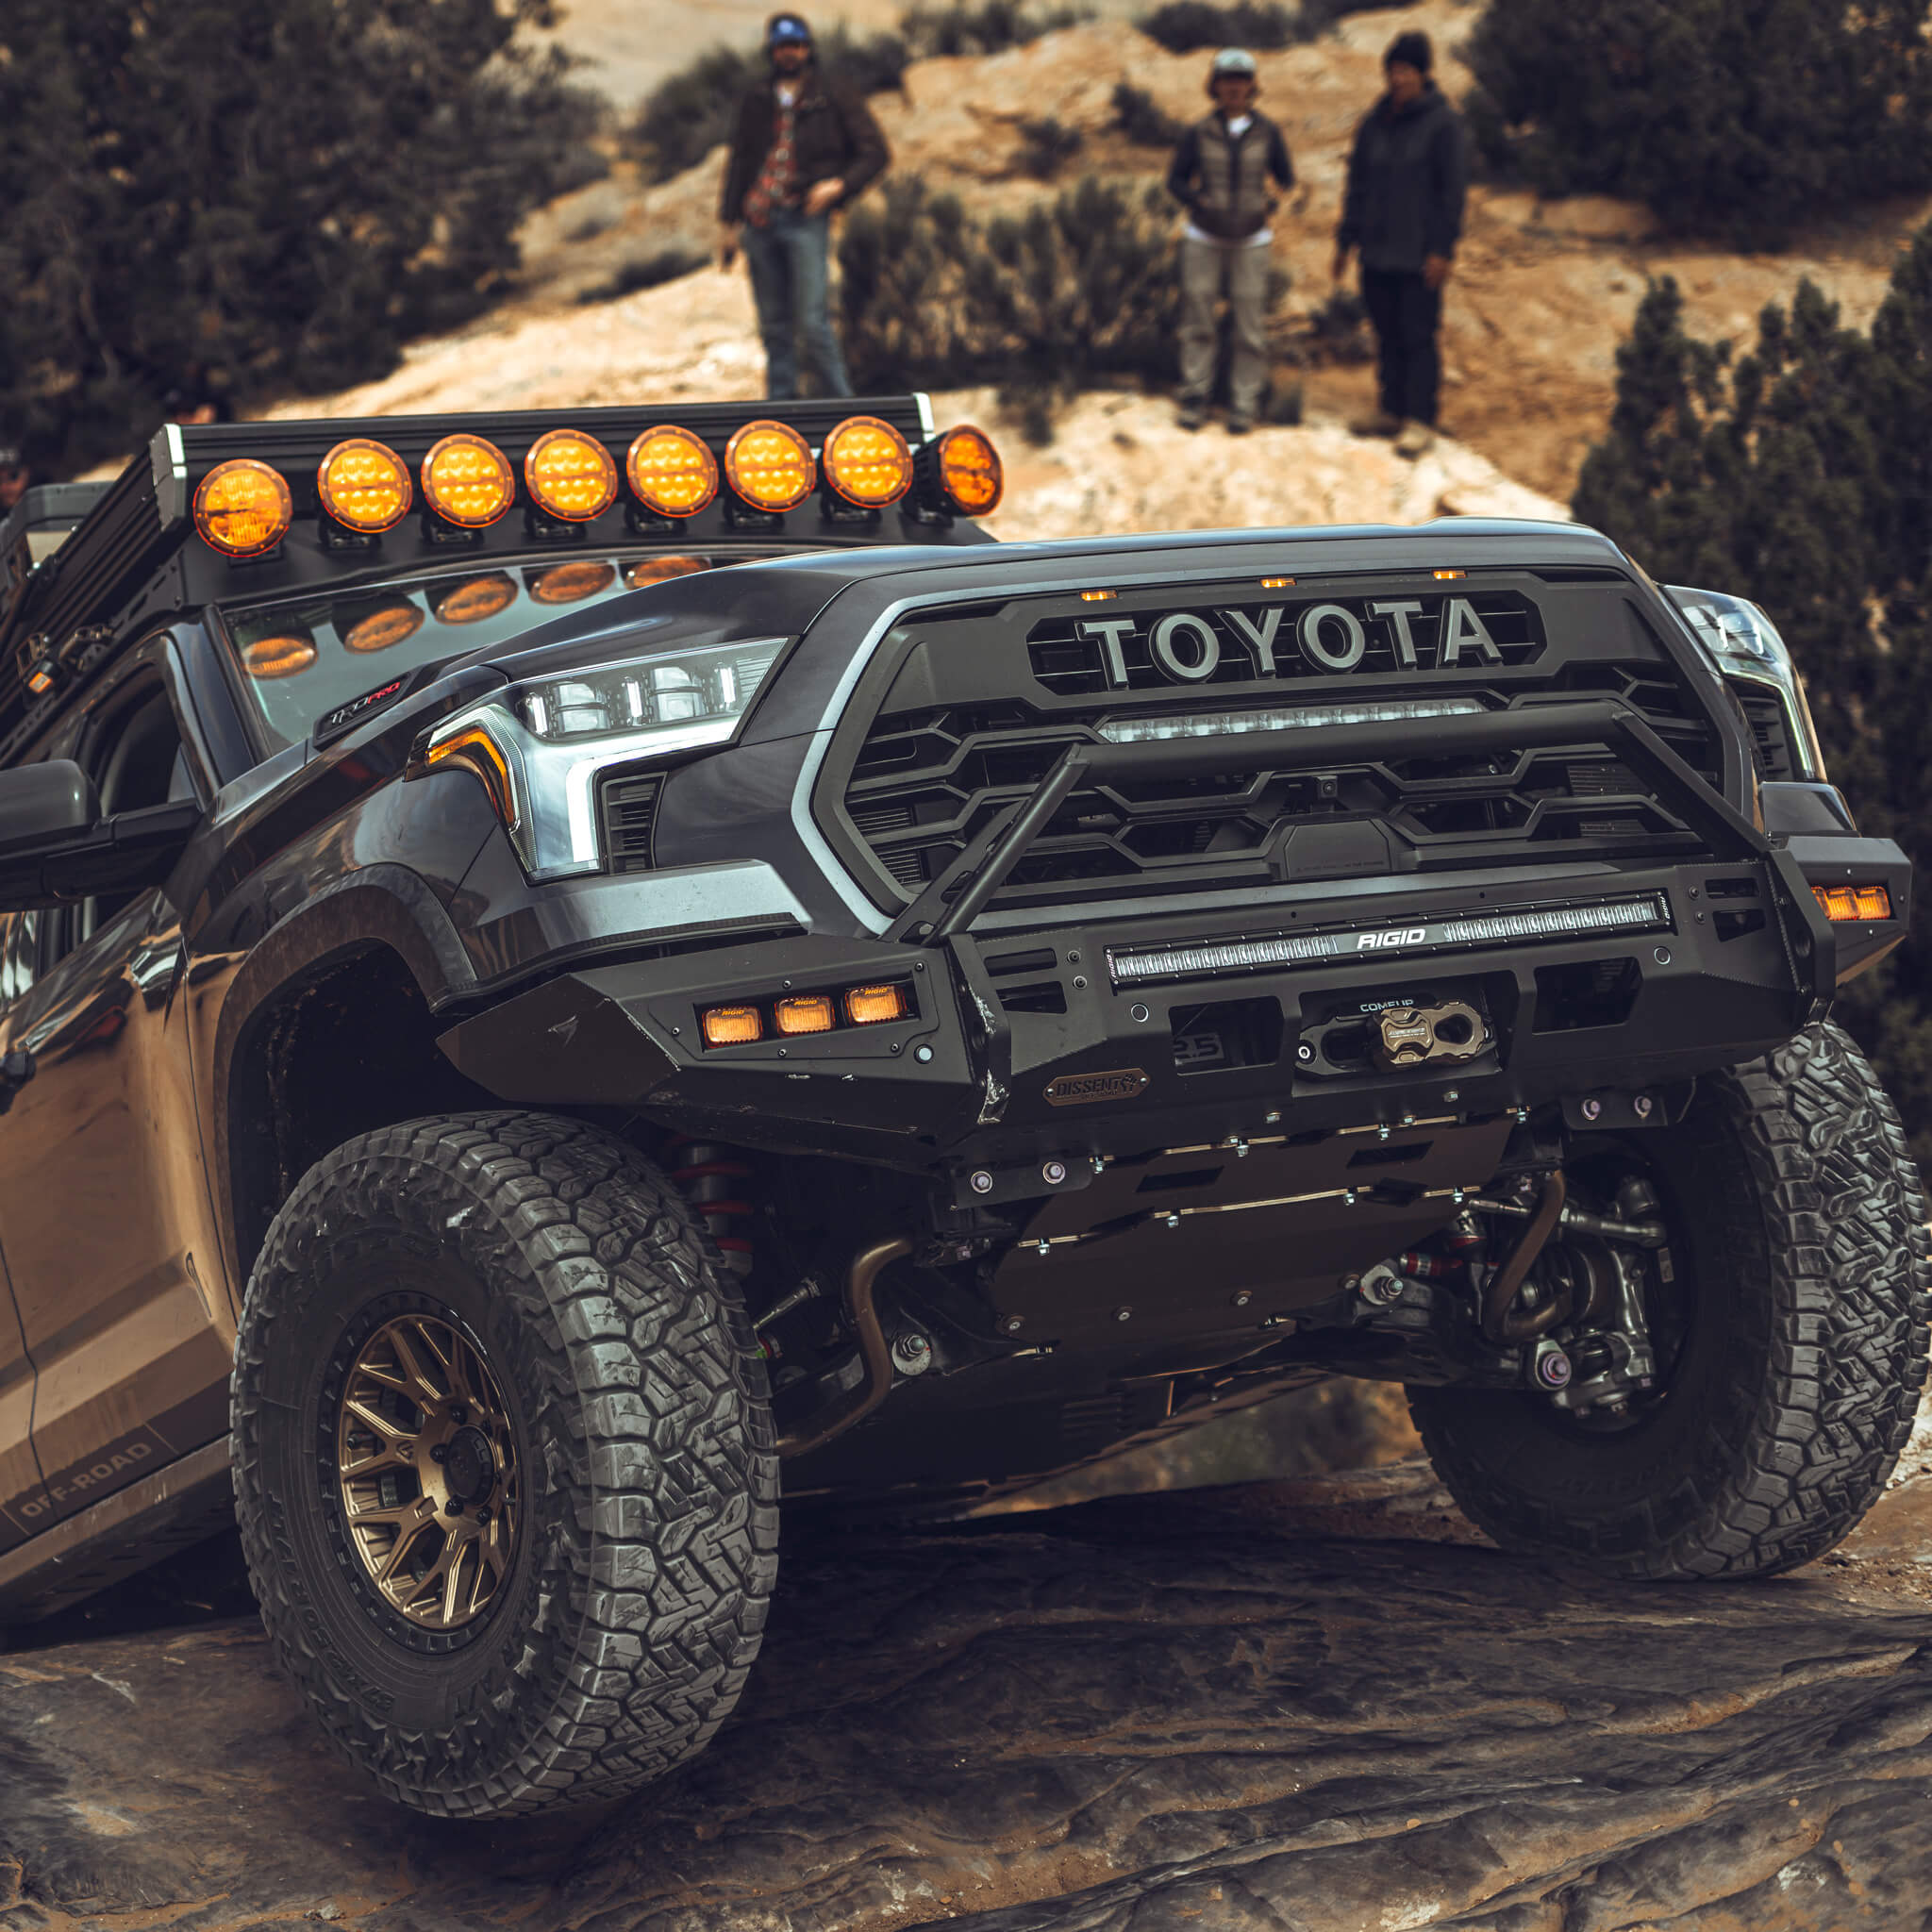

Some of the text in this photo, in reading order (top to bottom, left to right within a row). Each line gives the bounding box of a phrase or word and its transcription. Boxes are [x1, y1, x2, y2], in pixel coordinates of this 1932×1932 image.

[1077, 596, 1504, 690] TOYOTA
[1357, 928, 1426, 950] RIGID
[864, 987, 889, 996] RIGID
[1057, 1076, 1122, 1097] DISSENT
[20, 1441, 152, 1518] OFF-ROAD
